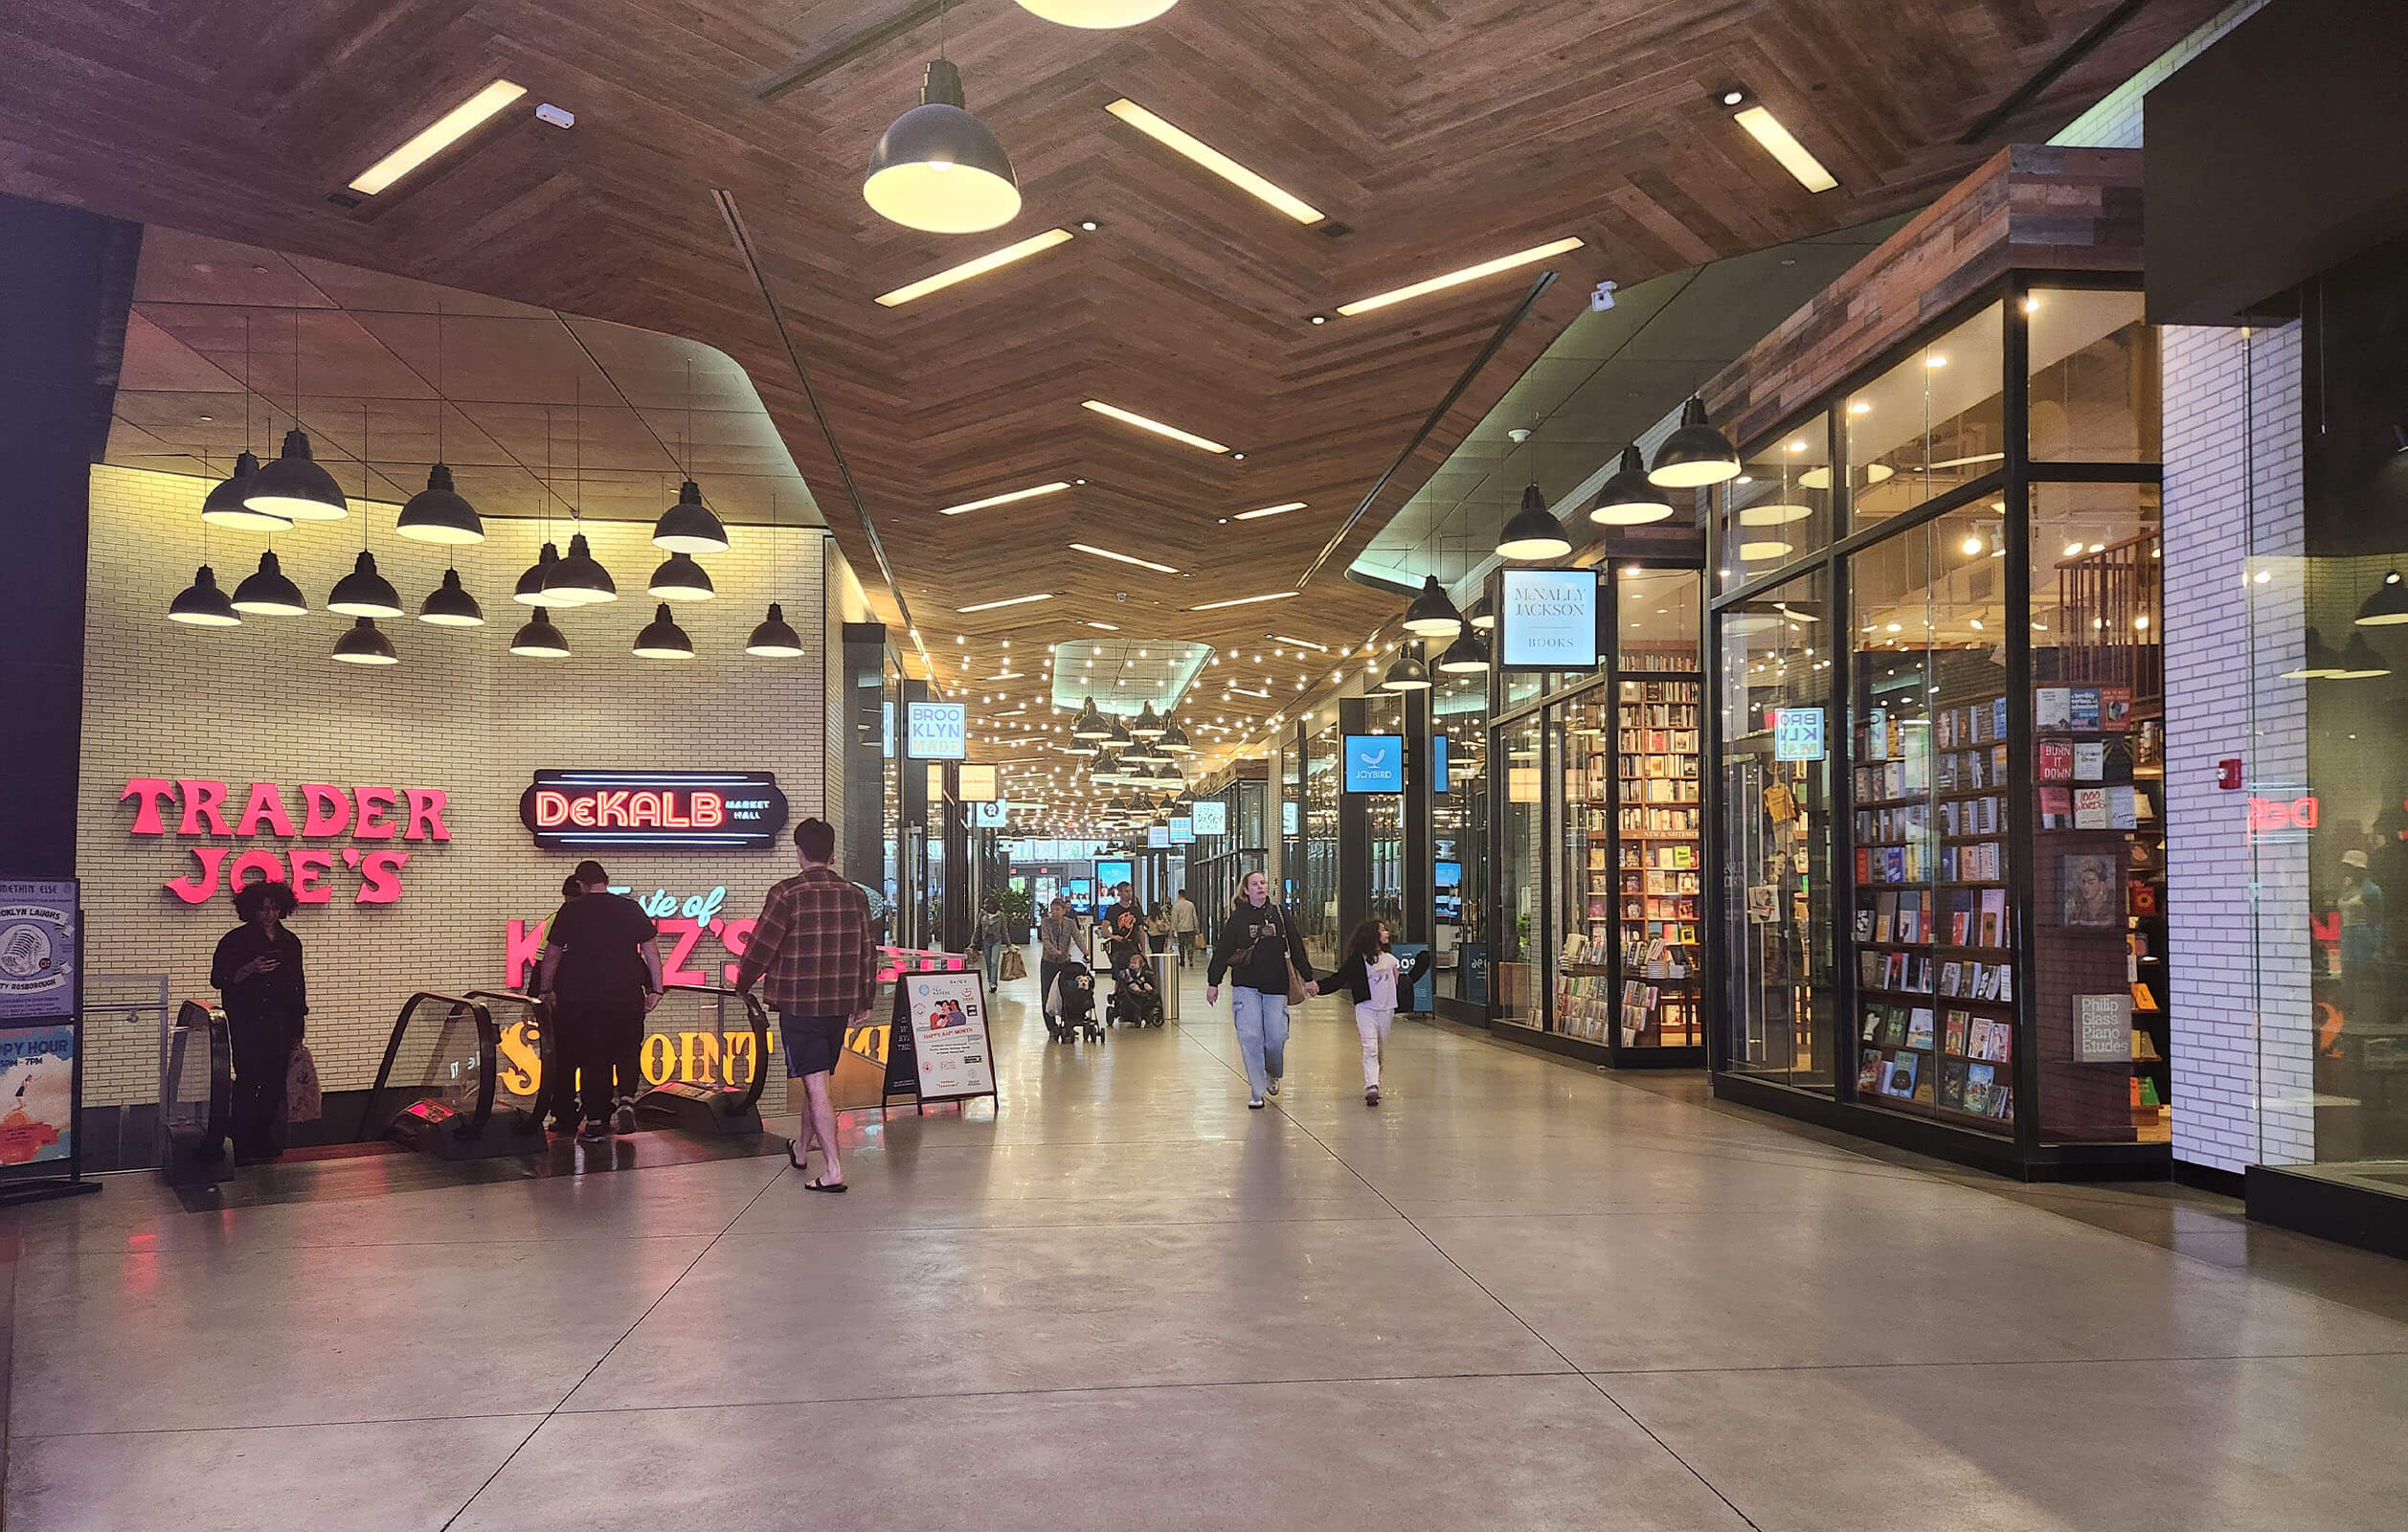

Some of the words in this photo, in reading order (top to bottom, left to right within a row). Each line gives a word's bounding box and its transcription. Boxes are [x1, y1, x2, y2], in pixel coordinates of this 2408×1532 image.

[1515, 603, 1585, 617] JACKSON
[1528, 638, 1574, 647] BOOKS
[912, 709, 960, 722] BROO
[912, 723, 960, 737] KLYN
[912, 740, 960, 753] MADE
[2045, 745, 2071, 756] BURN
[2054, 756, 2062, 767] IT
[1356, 770, 1392, 778] JOYBIRD
[2044, 768, 2072, 778] DOWN
[120, 777, 453, 840] TRADER
[724, 800, 772, 809] MARKET
[733, 811, 761, 820] HALL
[163, 847, 410, 904] JOE'S
[39, 885, 57, 894] ELSE
[681, 885, 727, 928] of
[29, 908, 60, 920] LAUGHS
[2082, 998, 2119, 1015] Philip
[2082, 1012, 2118, 1025] Glass
[2082, 1025, 2121, 1039] Piano
[28, 1039, 69, 1054] HOUR
[2082, 1039, 2128, 1053] Etudes
[25, 1056, 43, 1066] 7PM
